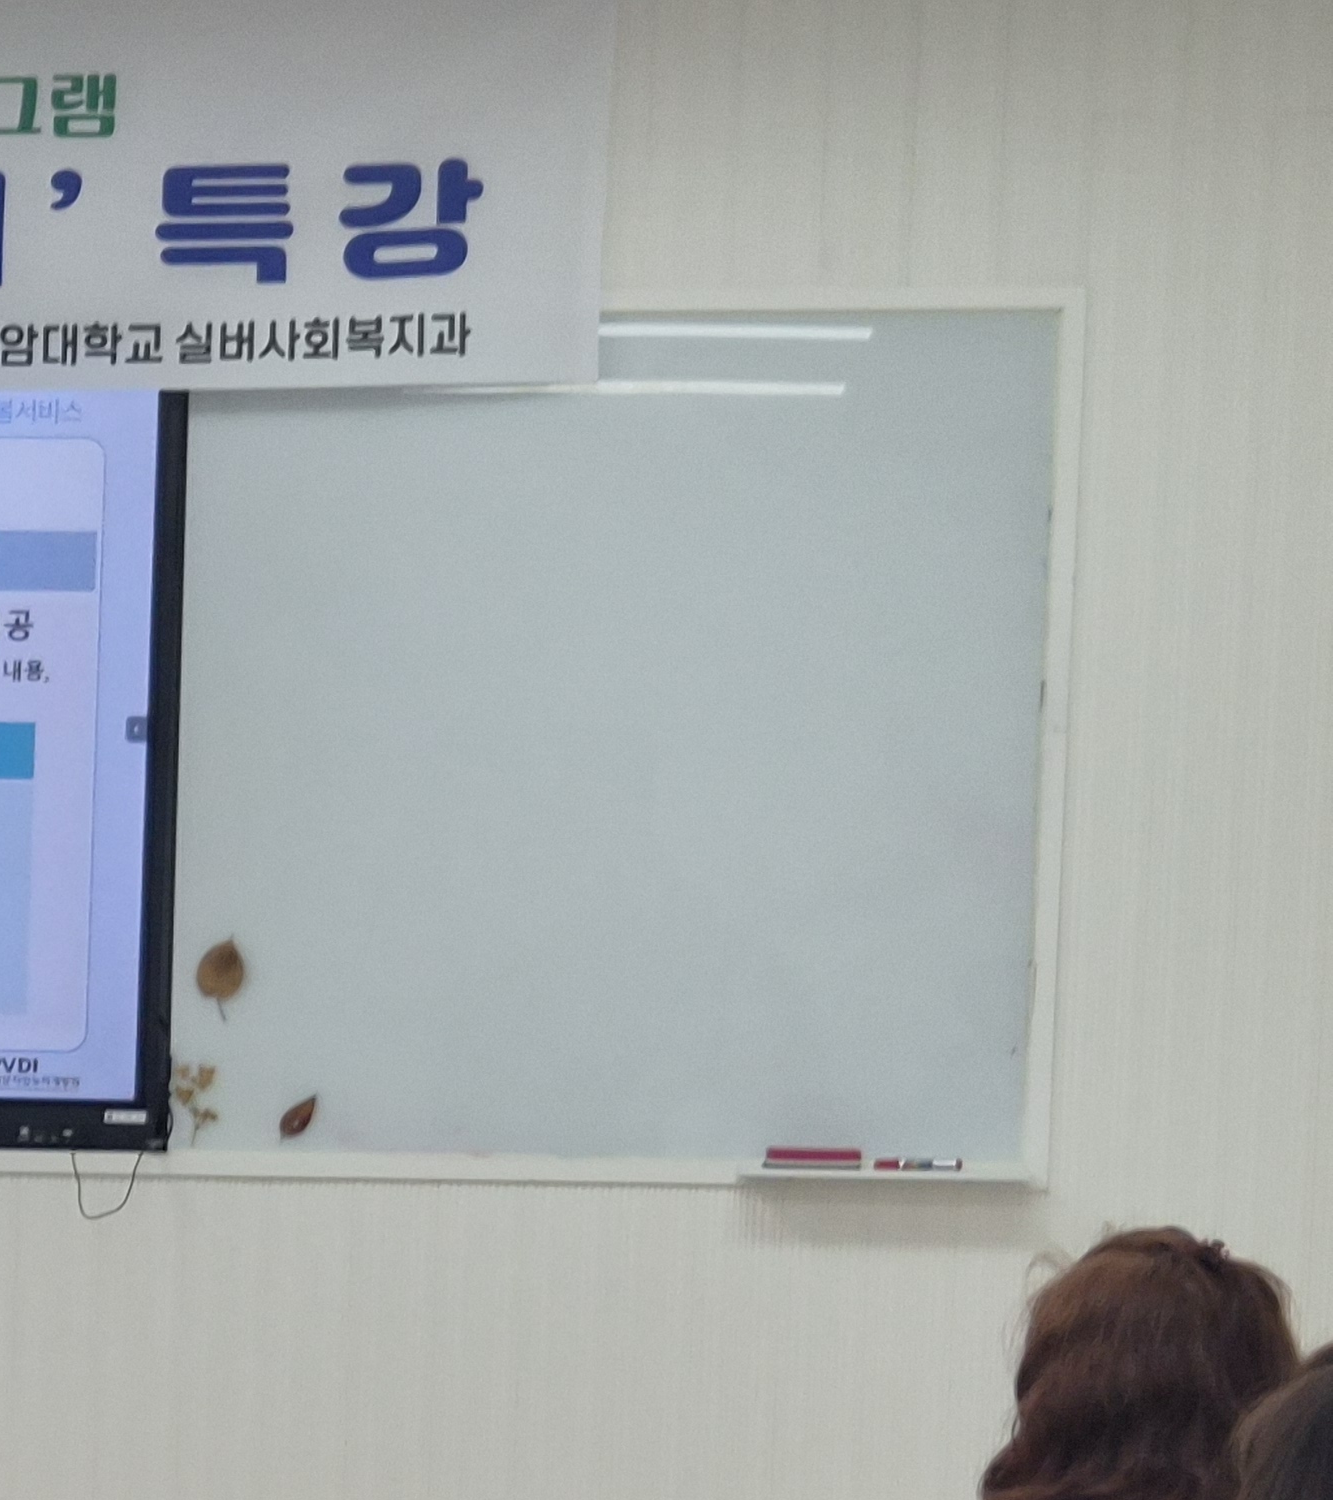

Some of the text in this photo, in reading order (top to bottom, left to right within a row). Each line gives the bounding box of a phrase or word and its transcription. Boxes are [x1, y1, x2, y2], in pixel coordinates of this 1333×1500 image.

[154, 157, 484, 285] 특강
[175, 311, 472, 365] 실버사회복지과
[2, 659, 50, 683] 내용,
